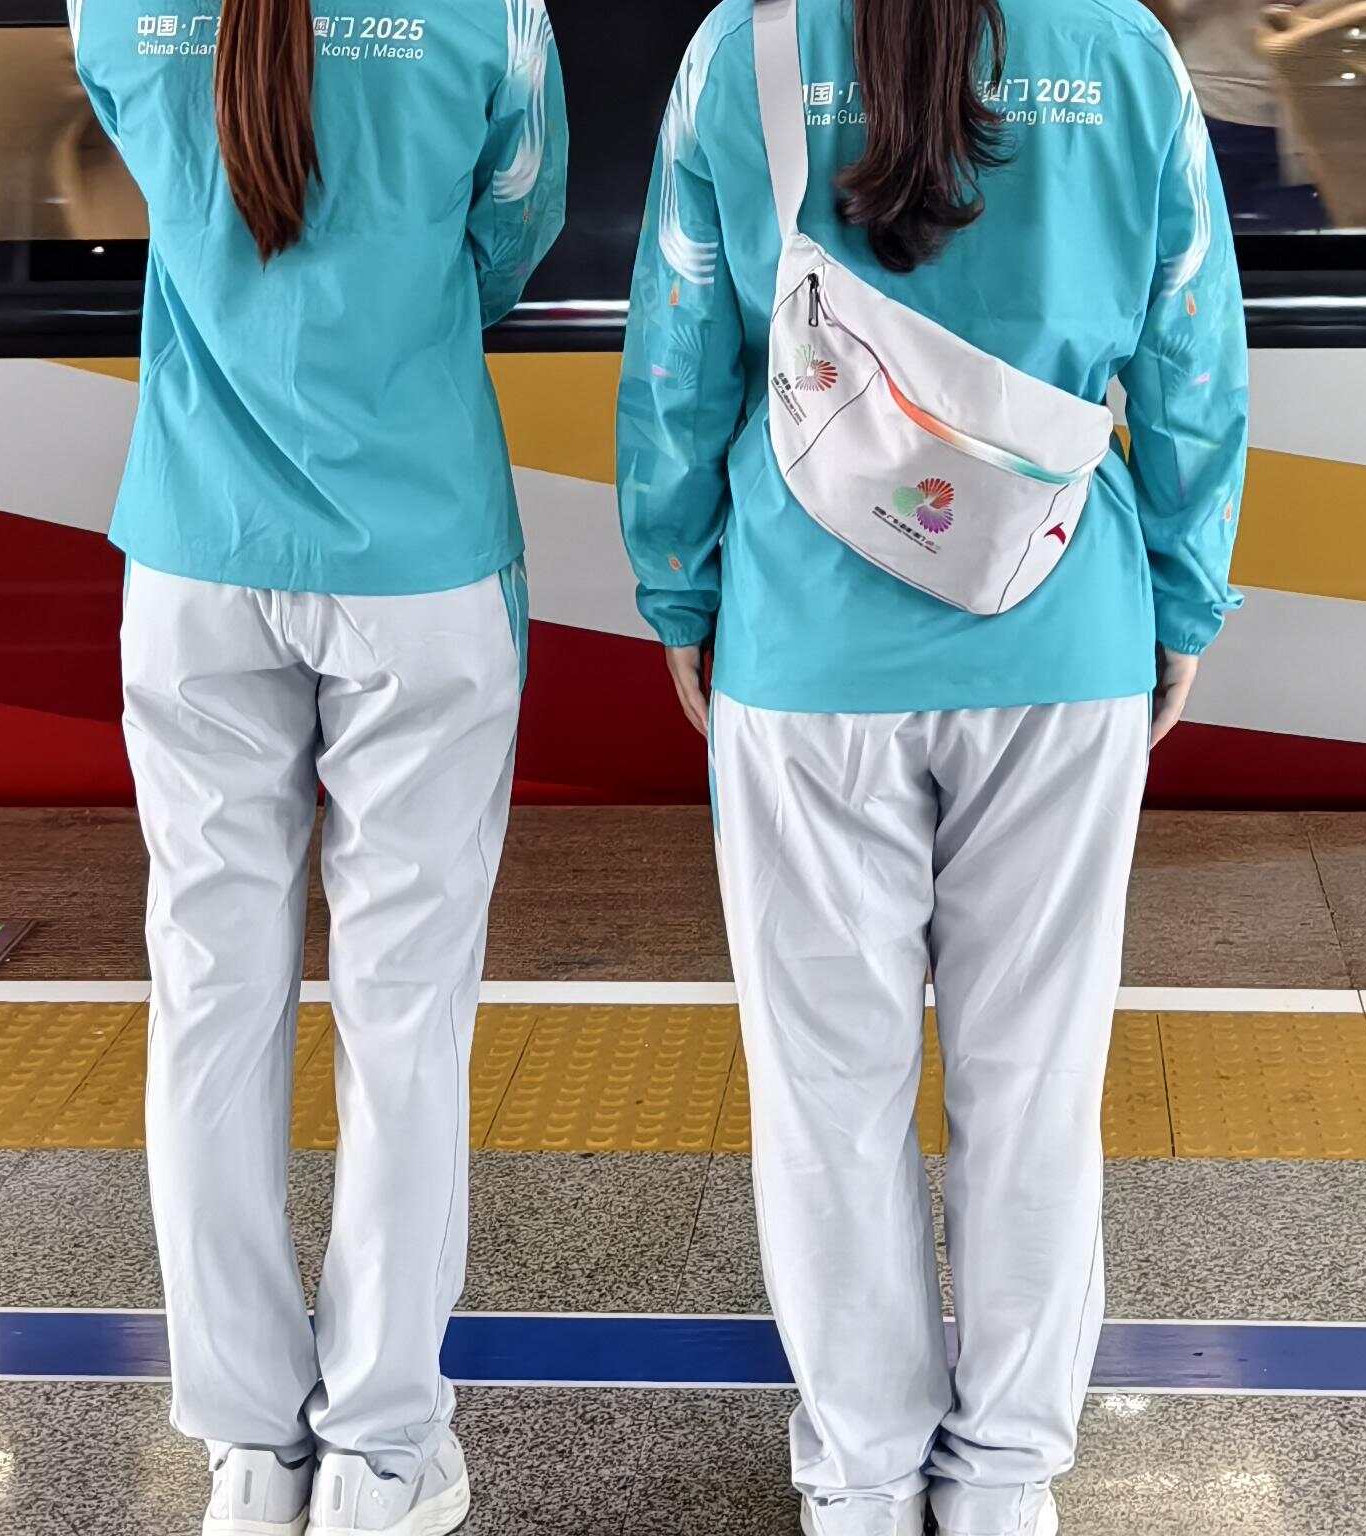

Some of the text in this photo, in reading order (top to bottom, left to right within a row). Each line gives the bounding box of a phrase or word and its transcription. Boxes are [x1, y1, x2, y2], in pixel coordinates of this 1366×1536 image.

[359, 16, 426, 41] 2025
[137, 40, 424, 60] China·Guan Kong Macao
[1035, 78, 1103, 105] 2025
[1051, 107, 1104, 125] Macao
